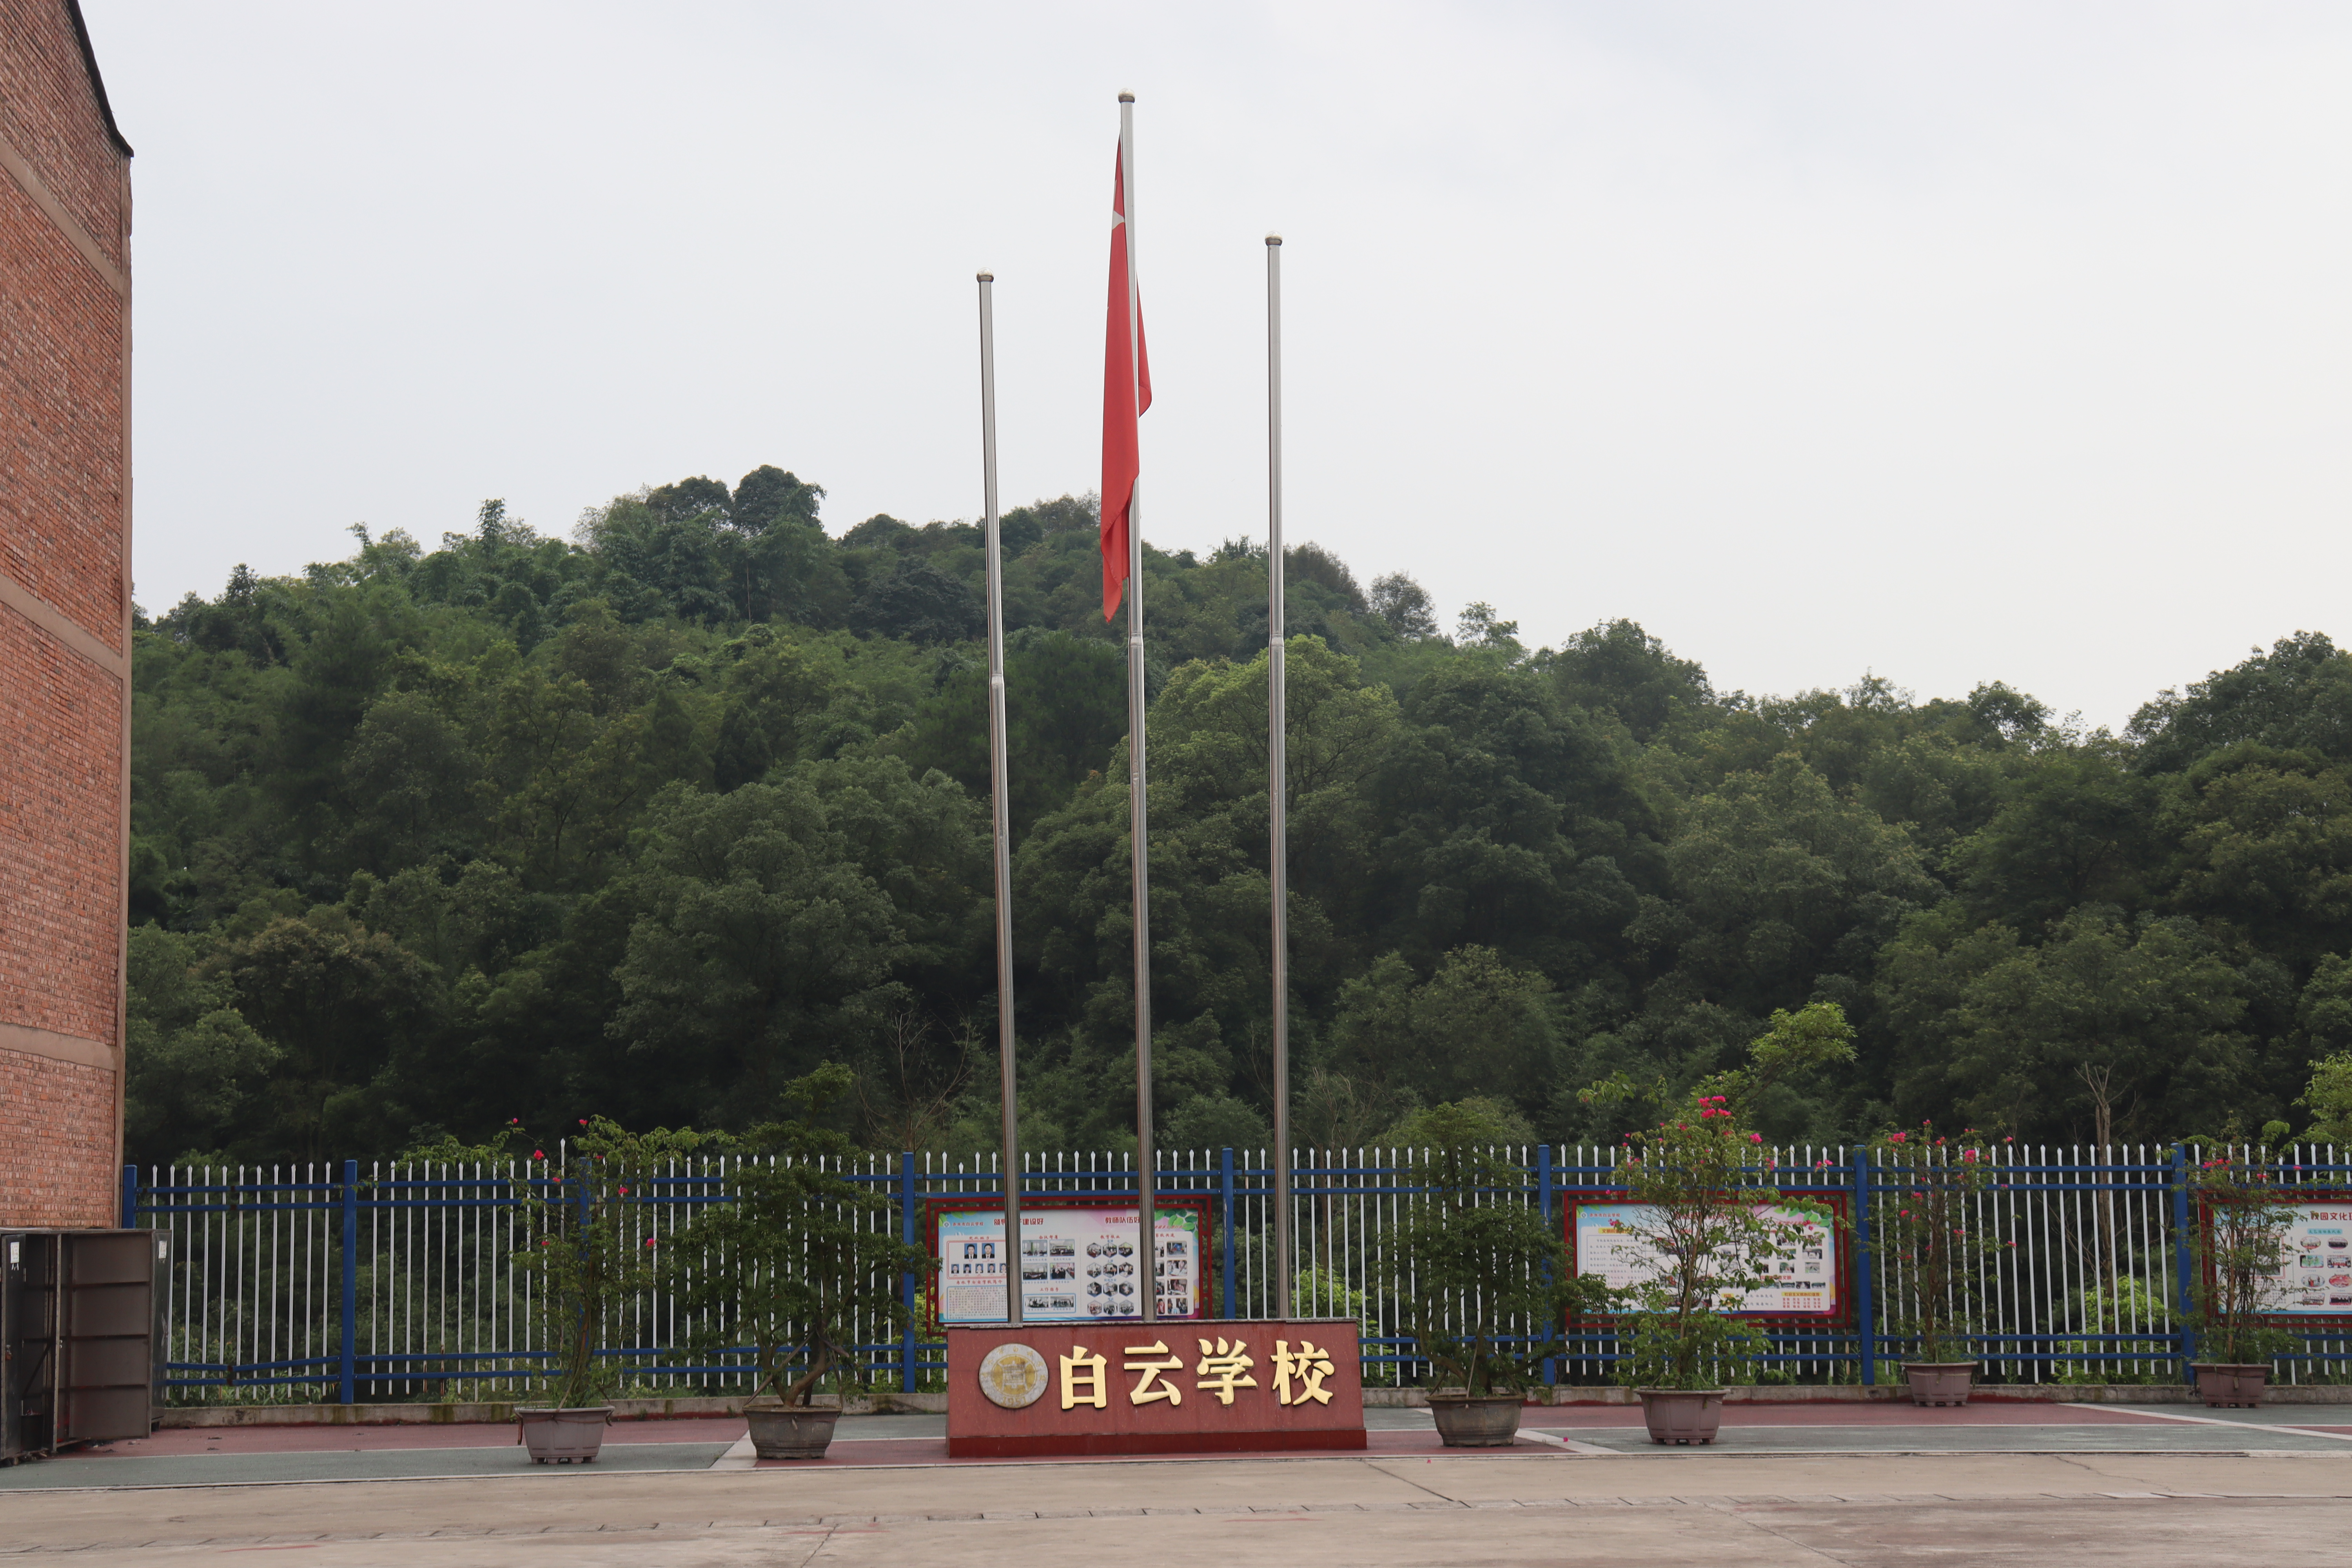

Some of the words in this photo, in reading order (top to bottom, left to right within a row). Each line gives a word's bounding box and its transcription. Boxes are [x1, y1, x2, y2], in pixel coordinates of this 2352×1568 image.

[1059, 1337, 1335, 1411] 白云学校
[1002, 1396, 1029, 1406] 1951
